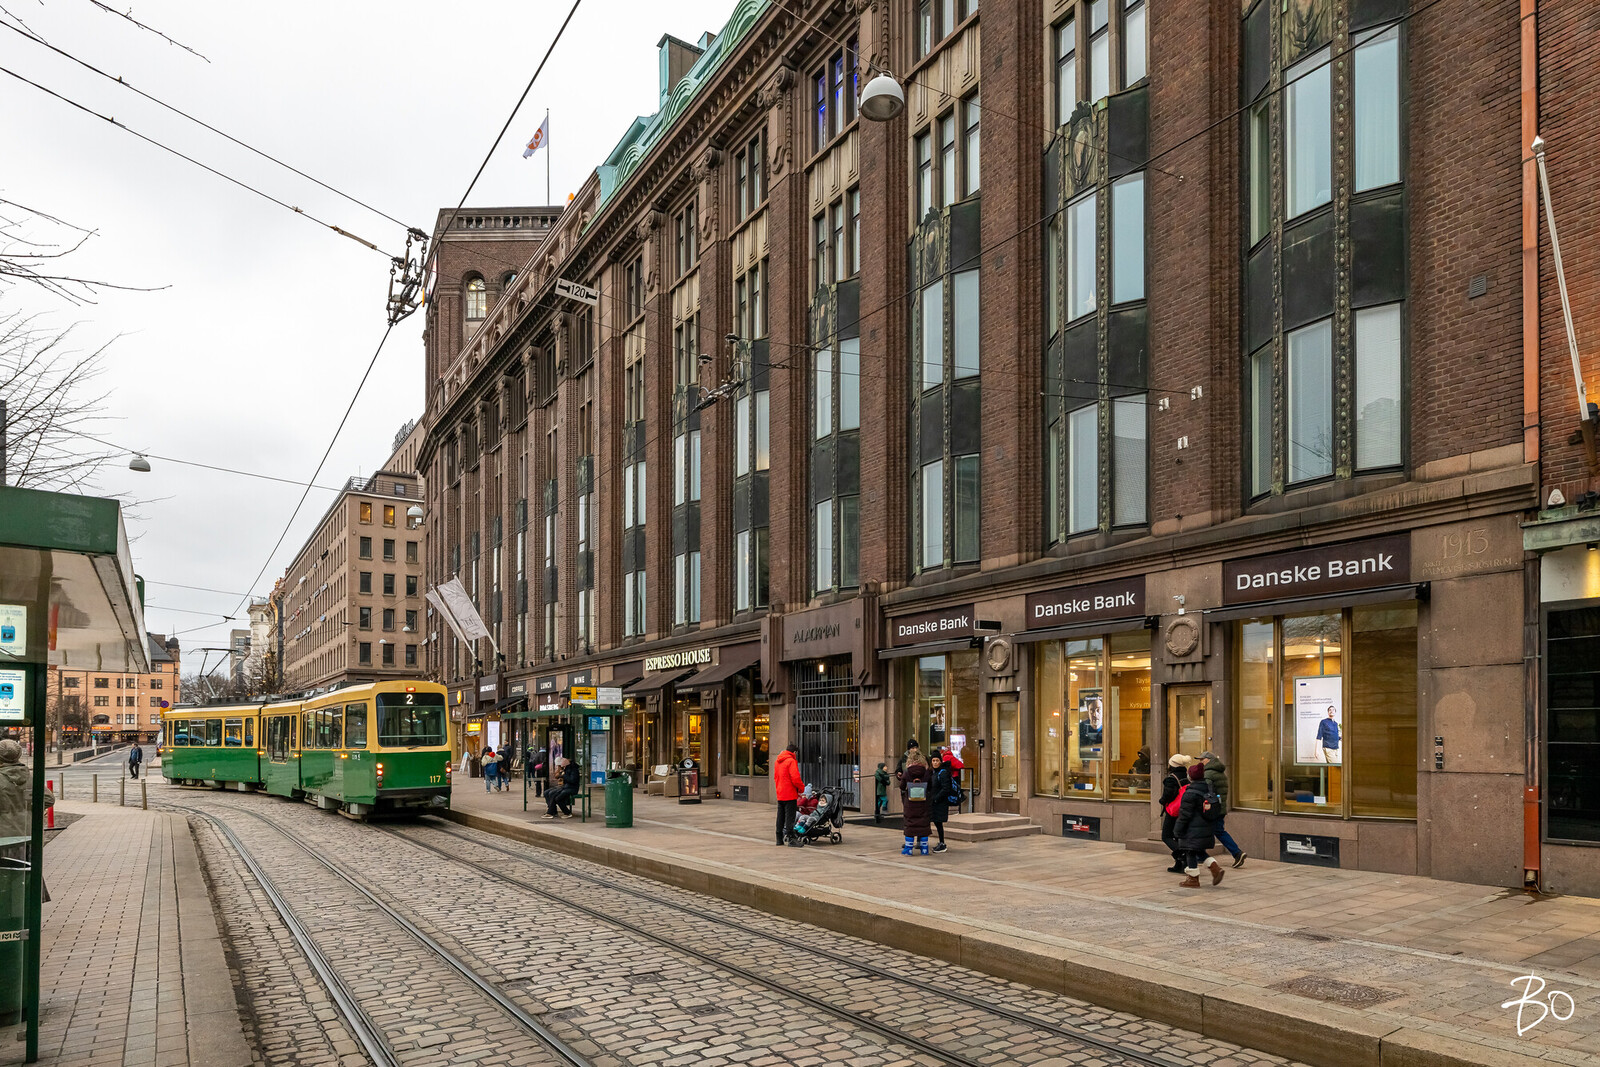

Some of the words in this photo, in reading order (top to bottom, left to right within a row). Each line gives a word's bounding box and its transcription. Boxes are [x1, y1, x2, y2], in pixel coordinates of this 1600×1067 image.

[571, 284, 586, 299] 120
[1443, 528, 1489, 559] 1913
[1236, 565, 1321, 590] Danske
[1328, 553, 1394, 578] Bank
[1035, 599, 1090, 618] Danske
[1094, 591, 1135, 610] Bank
[898, 621, 938, 637] Danske
[940, 615, 968, 631] Bank
[645, 653, 681, 671] ESPRESSO
[681, 648, 711, 666] HOUSE
[511, 685, 524, 693] COFFEE
[540, 681, 553, 690] LUNCH
[406, 694, 414, 705] 2
[429, 775, 442, 784] 117
